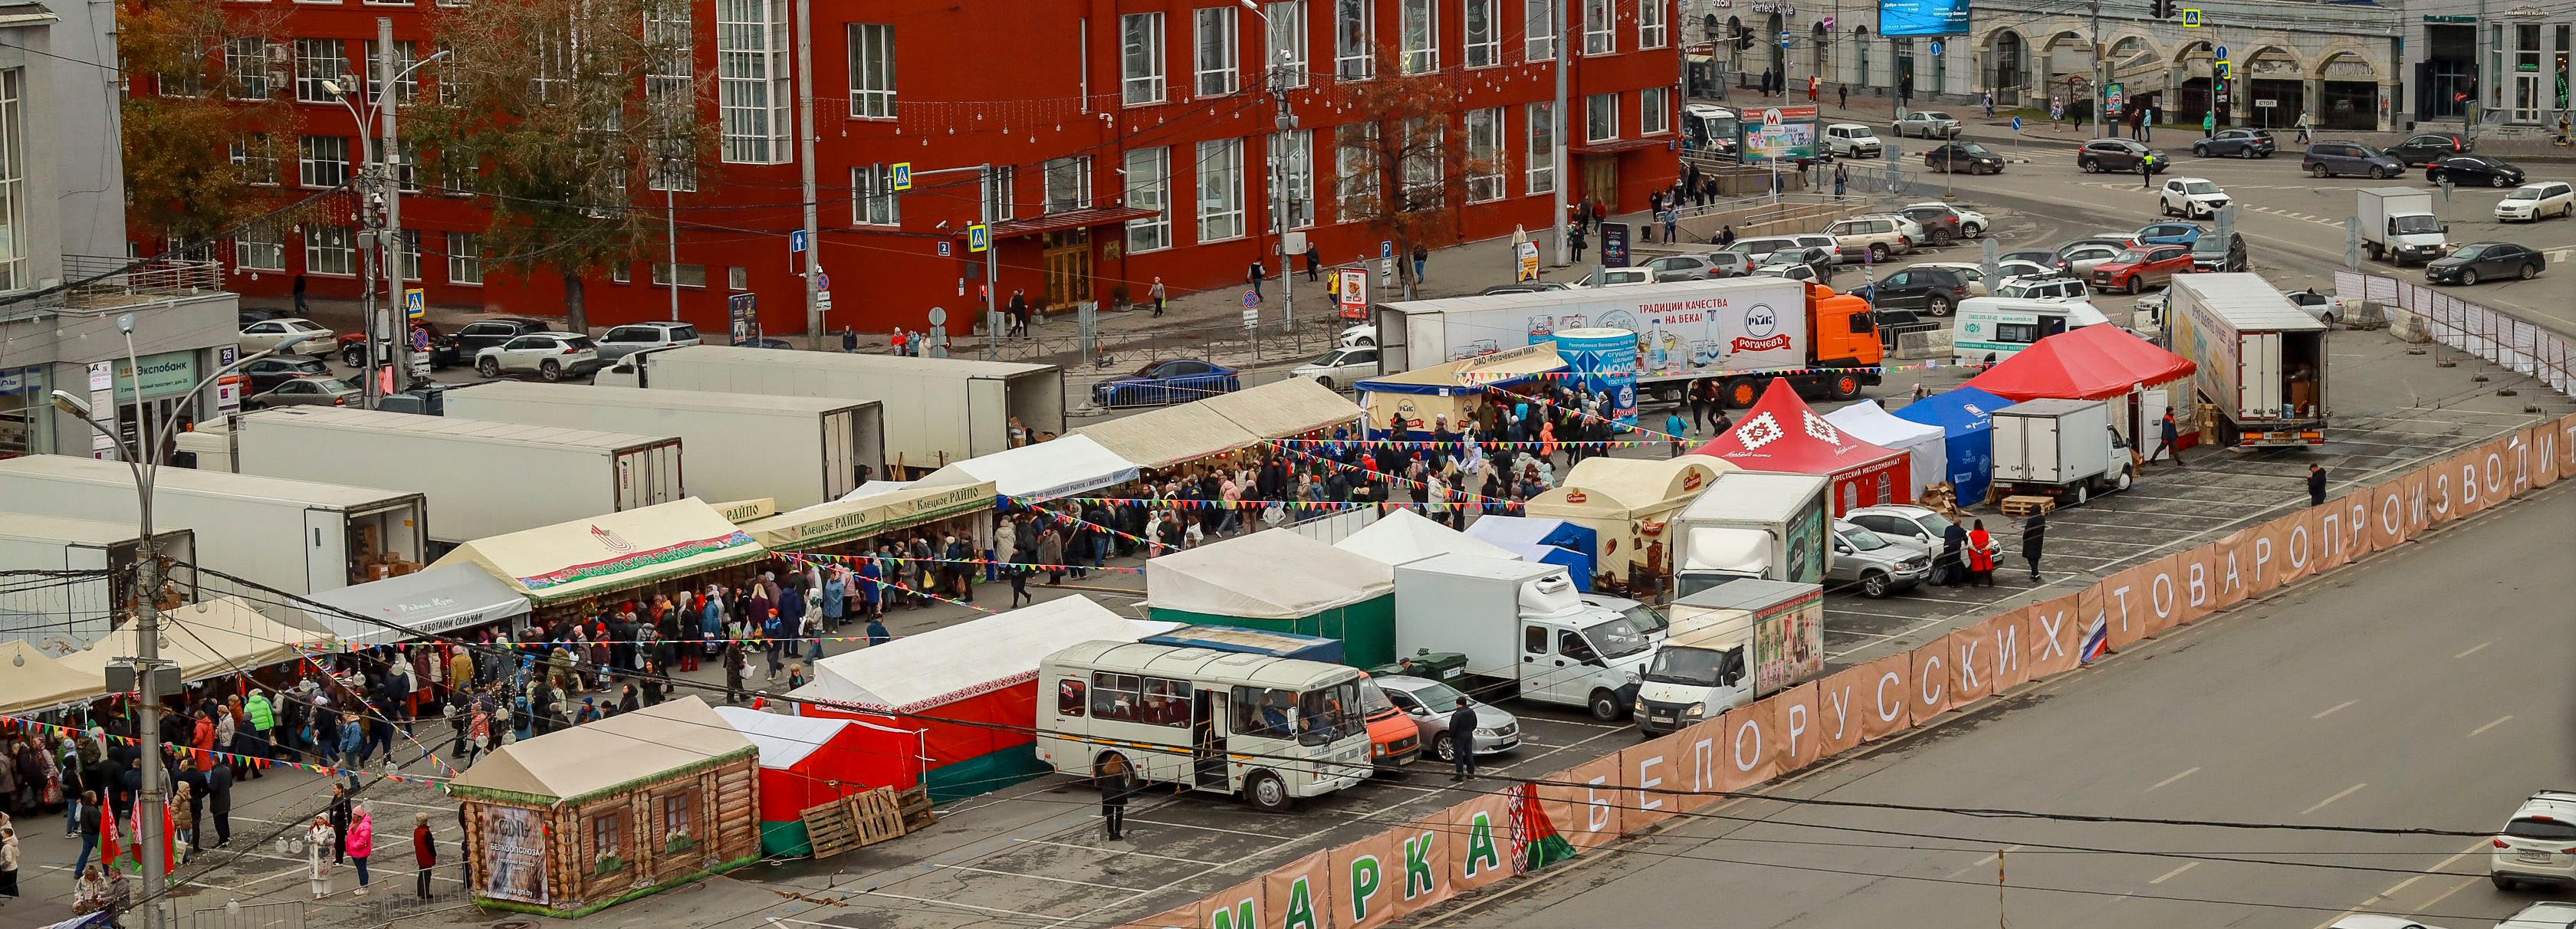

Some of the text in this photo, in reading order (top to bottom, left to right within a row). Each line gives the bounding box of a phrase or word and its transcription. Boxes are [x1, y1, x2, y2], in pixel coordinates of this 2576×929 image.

[1751, 1, 1795, 16] Perfect Syle
[1766, 113, 1779, 125] М
[1383, 243, 1390, 254] P
[1638, 298, 1728, 313] ТРАДИЦИИ КАЧЕСТВА
[1665, 314, 1704, 324] НА ВЕКА!
[1748, 314, 1773, 326] РМК
[222, 349, 232, 359] 25
[1474, 356, 1487, 366] ОАО
[137, 362, 187, 376] Экспобанк
[1832, 458, 1901, 483] БРЕСТСКИЙ МЯСОКОМБИНАТ
[917, 486, 979, 510] Клецкое РАЙПО
[726, 504, 759, 520] РАЙПО
[801, 512, 866, 537] Клецкое РАЙПО
[2114, 426, 2576, 632] ТОВАРОПРОИЗВОДИТ
[578, 553, 654, 576] КИРОВСКОЕ
[654, 543, 702, 564] РАЙПО
[420, 619, 454, 633] ЗАБОТАМИ
[455, 612, 484, 626] СЕЛЬЧАН
[1588, 610, 2065, 832] БЕЛОРУССКИХ
[490, 843, 540, 857] БЕЛКООПСОЮЗА
